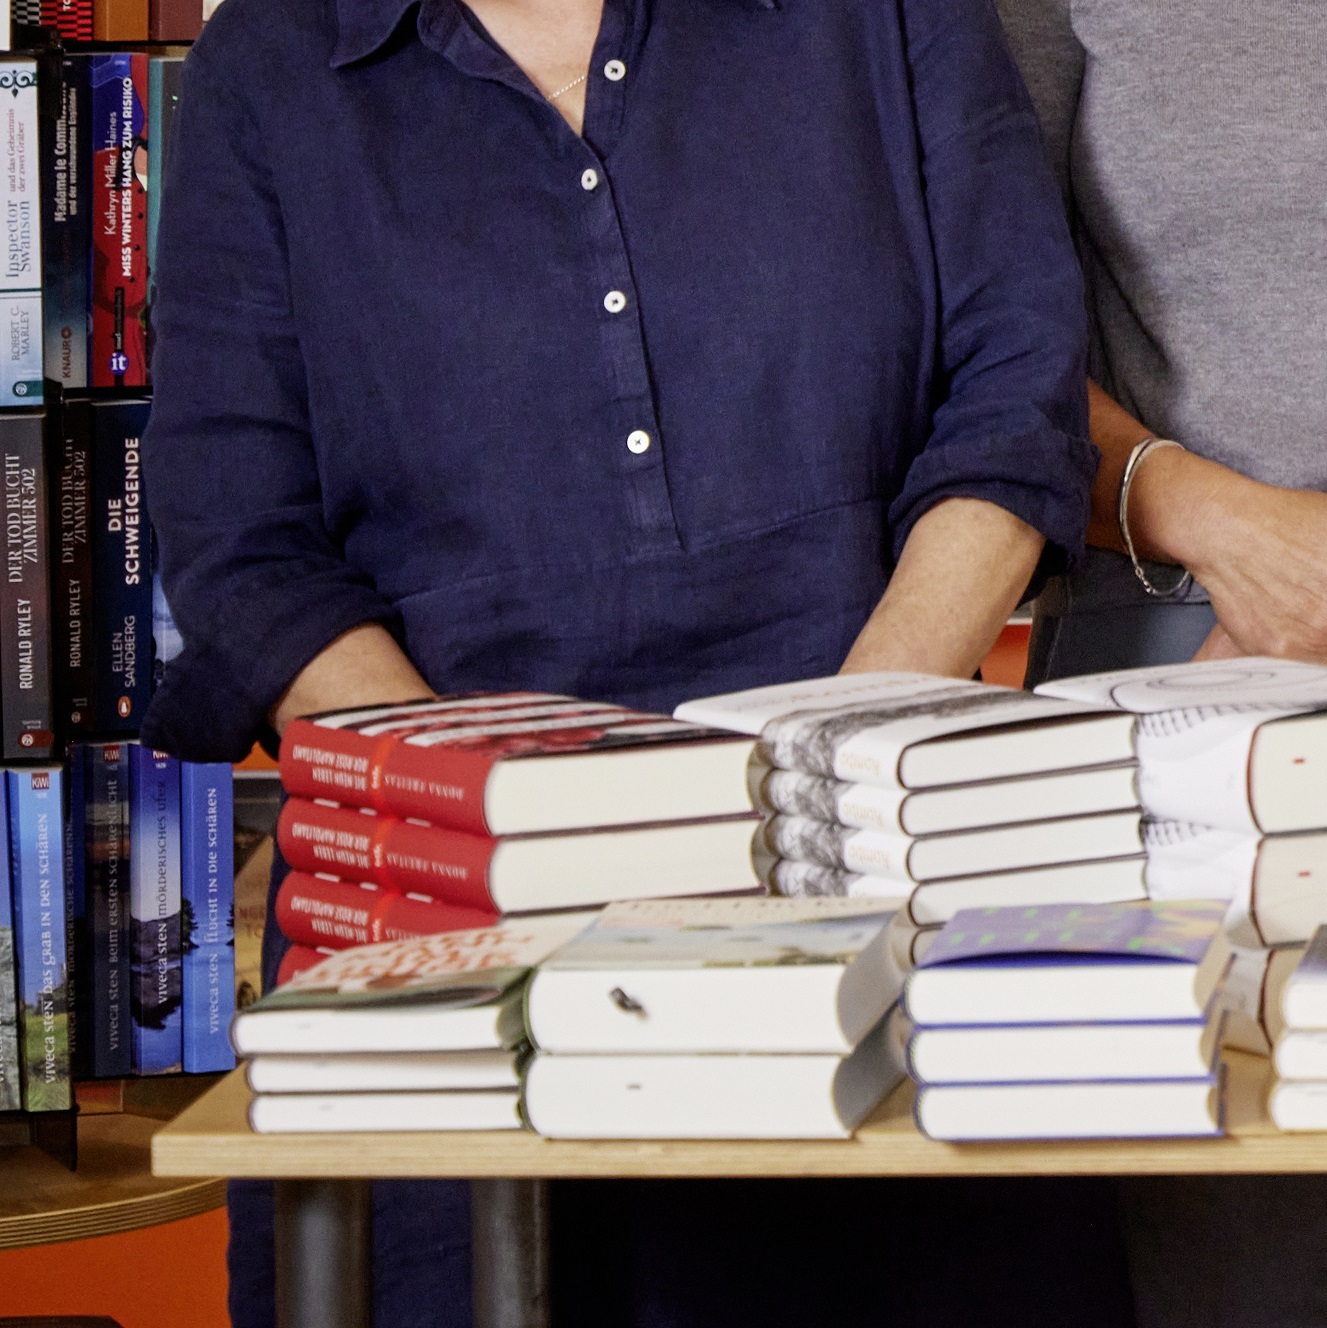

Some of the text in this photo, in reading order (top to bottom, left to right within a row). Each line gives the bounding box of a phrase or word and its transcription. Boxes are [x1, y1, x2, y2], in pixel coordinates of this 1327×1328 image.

[6, 108, 17, 193] und das Geheimnis
[16, 120, 27, 193] der zwei Gräber
[53, 158, 67, 171] le
[104, 110, 119, 235] Kathryn Miller Haines
[121, 77, 134, 277] MISS WINTERS HANG ZUM RISIKO
[54, 172, 68, 223] Madame
[5, 199, 23, 279] Inspector
[17, 199, 31, 273] Swanson
[10, 319, 21, 362] ROBERT
[20, 309, 31, 356] MARLEY
[61, 338, 73, 379] KNAUR
[5, 452, 23, 584] DER TOD BUCHT
[21, 467, 38, 564] ZIMMER 502
[107, 498, 122, 533] DIE
[125, 437, 139, 586] SCHWEIGENDE
[17, 598, 34, 690] RONALD RYLEY
[68, 578, 82, 668] RONALD RYLEY
[112, 631, 123, 674] ELLEN
[123, 615, 137, 688] SANDBERG
